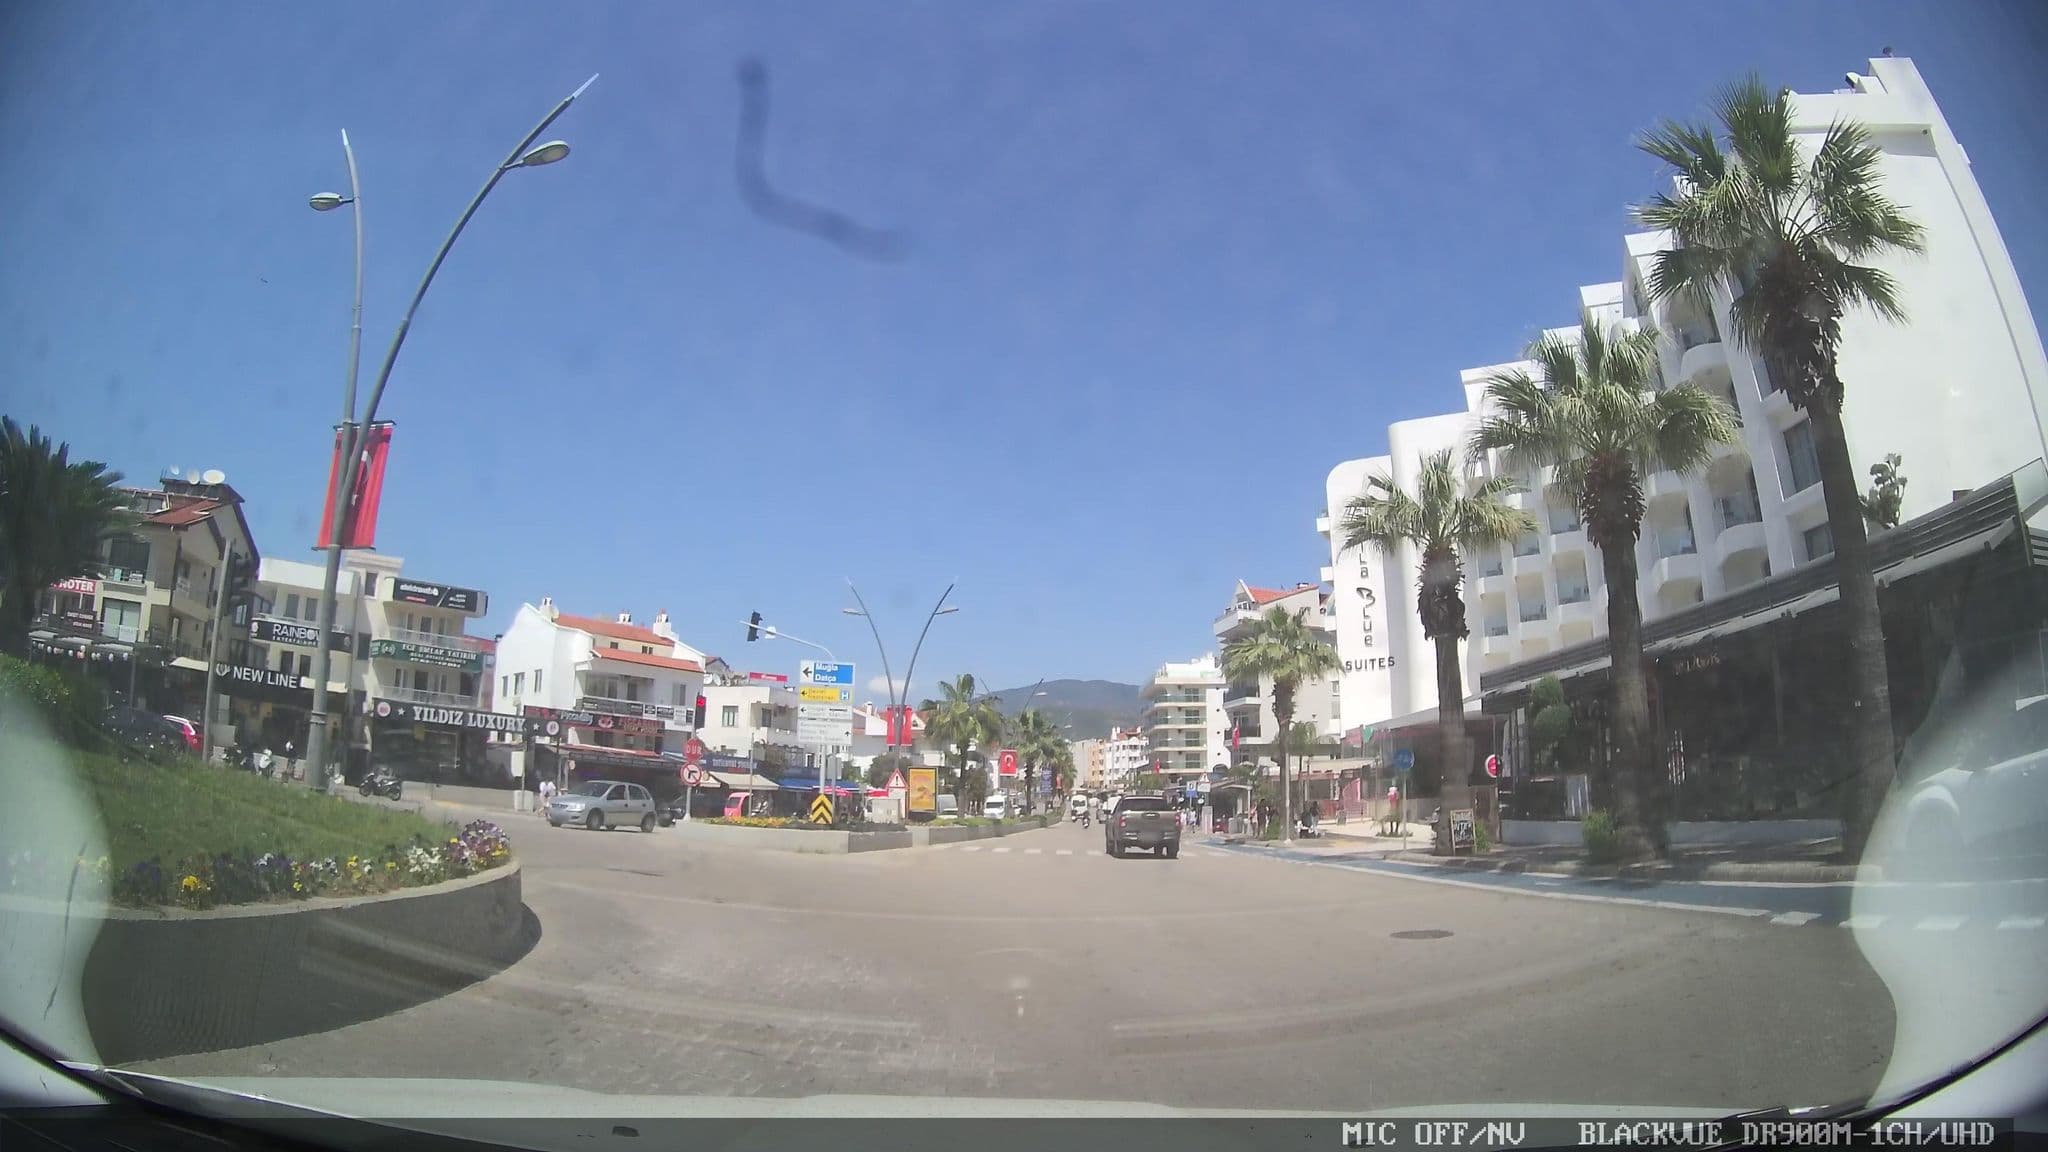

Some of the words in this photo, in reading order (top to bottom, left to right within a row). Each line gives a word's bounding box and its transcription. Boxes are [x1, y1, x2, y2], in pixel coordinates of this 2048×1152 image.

[60, 579, 94, 592] NOTER
[1345, 656, 1395, 671] SUITES
[233, 665, 265, 683] NEW
[267, 671, 298, 689] LINE
[413, 705, 463, 726] YILDIZ
[467, 711, 527, 732] LUXURY
[686, 744, 702, 755] DUR
